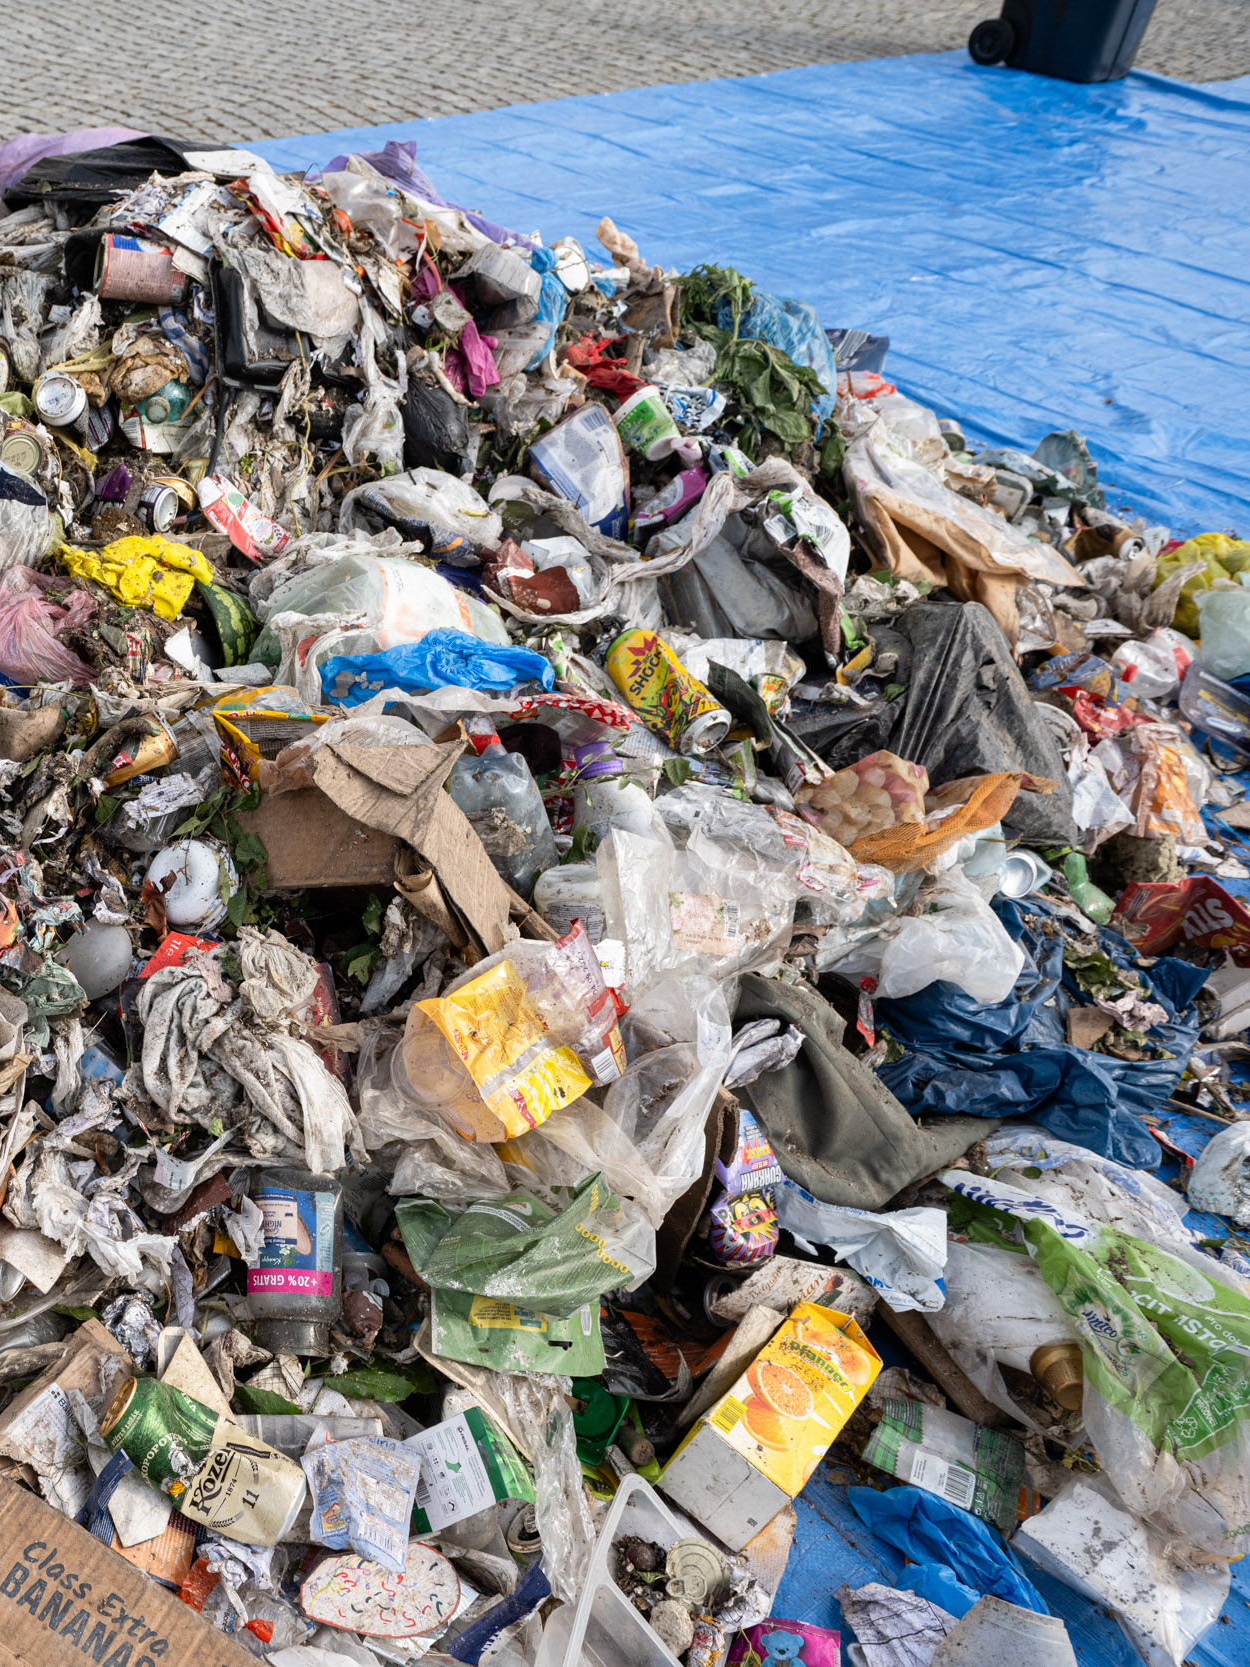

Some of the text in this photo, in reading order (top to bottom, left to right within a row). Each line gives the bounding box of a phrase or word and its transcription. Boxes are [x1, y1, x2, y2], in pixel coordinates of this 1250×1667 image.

[642, 652, 652, 668] BIG
[741, 1165, 782, 1191] GUARANA
[253, 1275, 318, 1287] +20% GRATIS
[1205, 1315, 1222, 1331] Pro
[789, 1340, 848, 1388] pfanner
[188, 1448, 231, 1517] Kozel
[226, 1479, 237, 1497] 1874
[242, 1489, 260, 1509] 11
[23, 1541, 170, 1657] Class Extra
